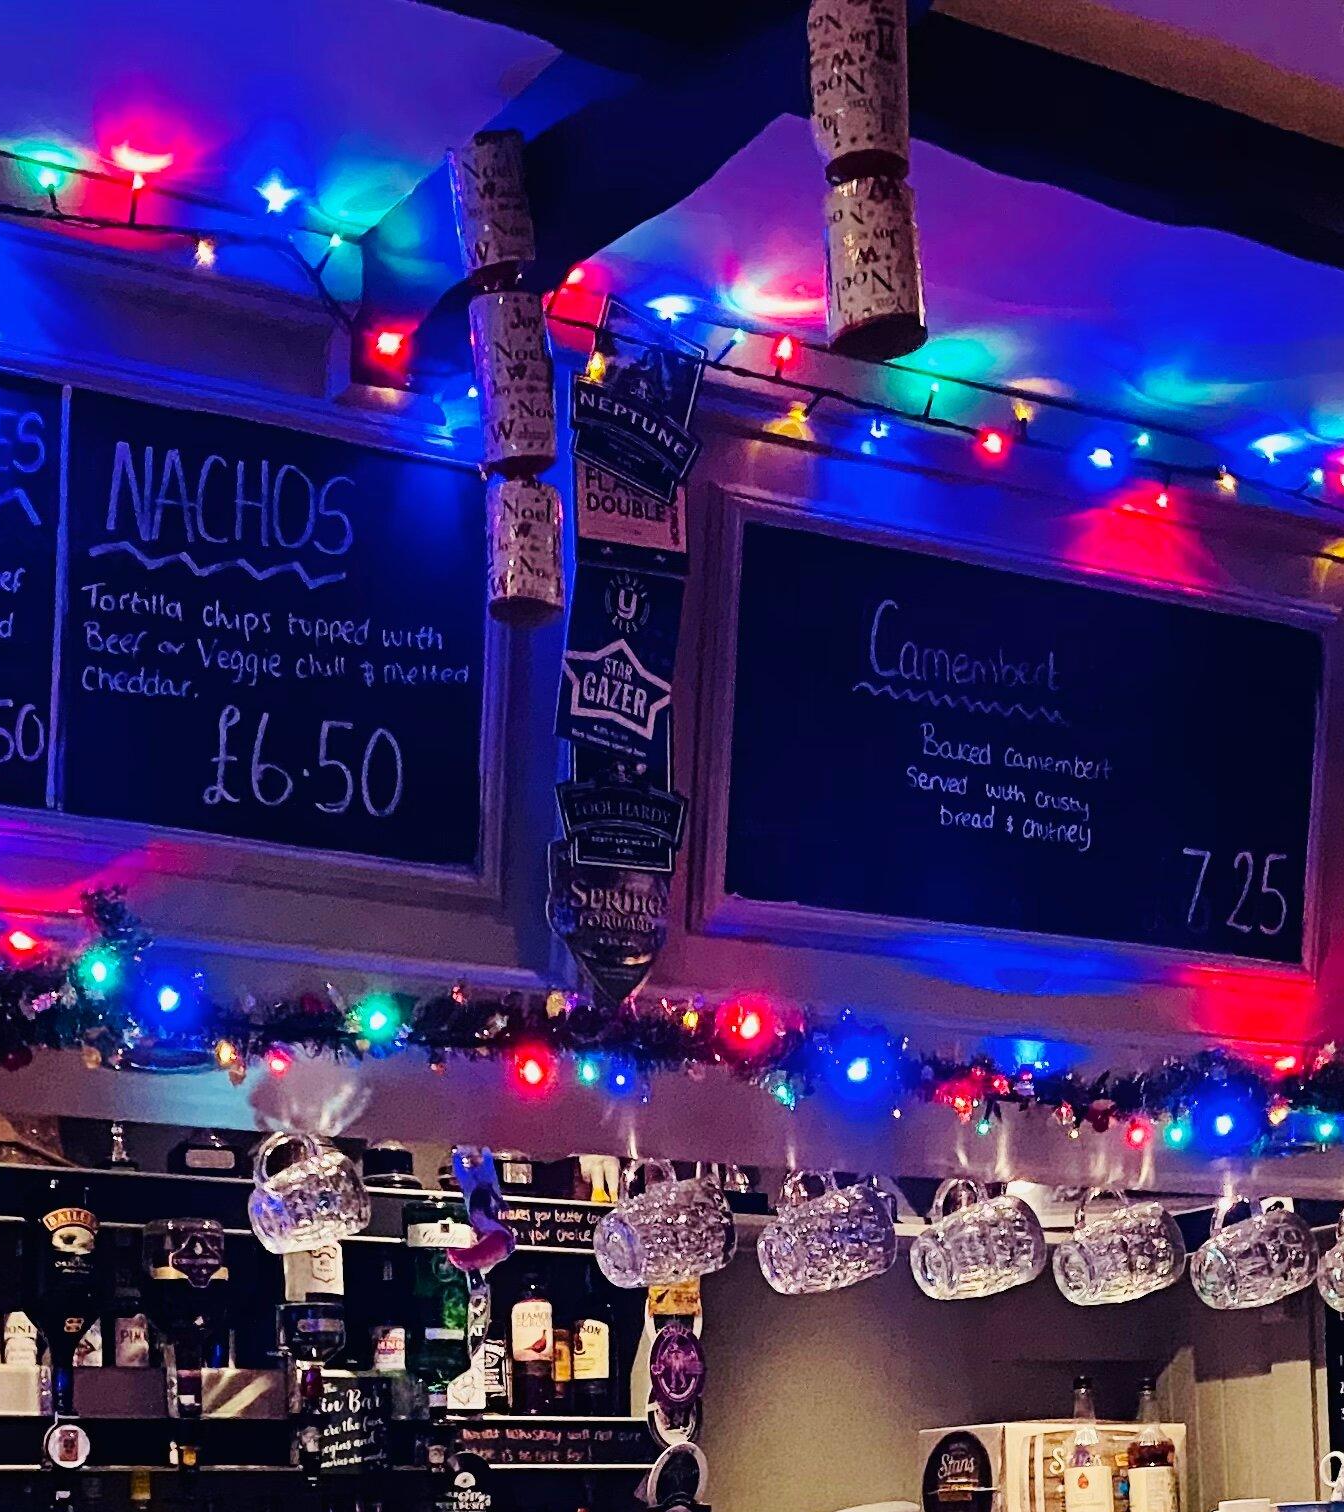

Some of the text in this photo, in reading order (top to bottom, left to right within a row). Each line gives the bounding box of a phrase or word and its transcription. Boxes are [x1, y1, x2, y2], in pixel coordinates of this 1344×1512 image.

[579, 390, 688, 459] NEPTUNE
[106, 441, 355, 555] NACHOS
[81, 582, 444, 652] Tortilla chips topped with
[84, 621, 149, 656] Beef
[869, 599, 1062, 691] Camembert
[582, 671, 648, 719] GAZER
[604, 657, 633, 682] STAR
[203, 704, 404, 817] £6.50
[920, 722, 991, 765] Baked
[937, 1453, 977, 1480] Stans
